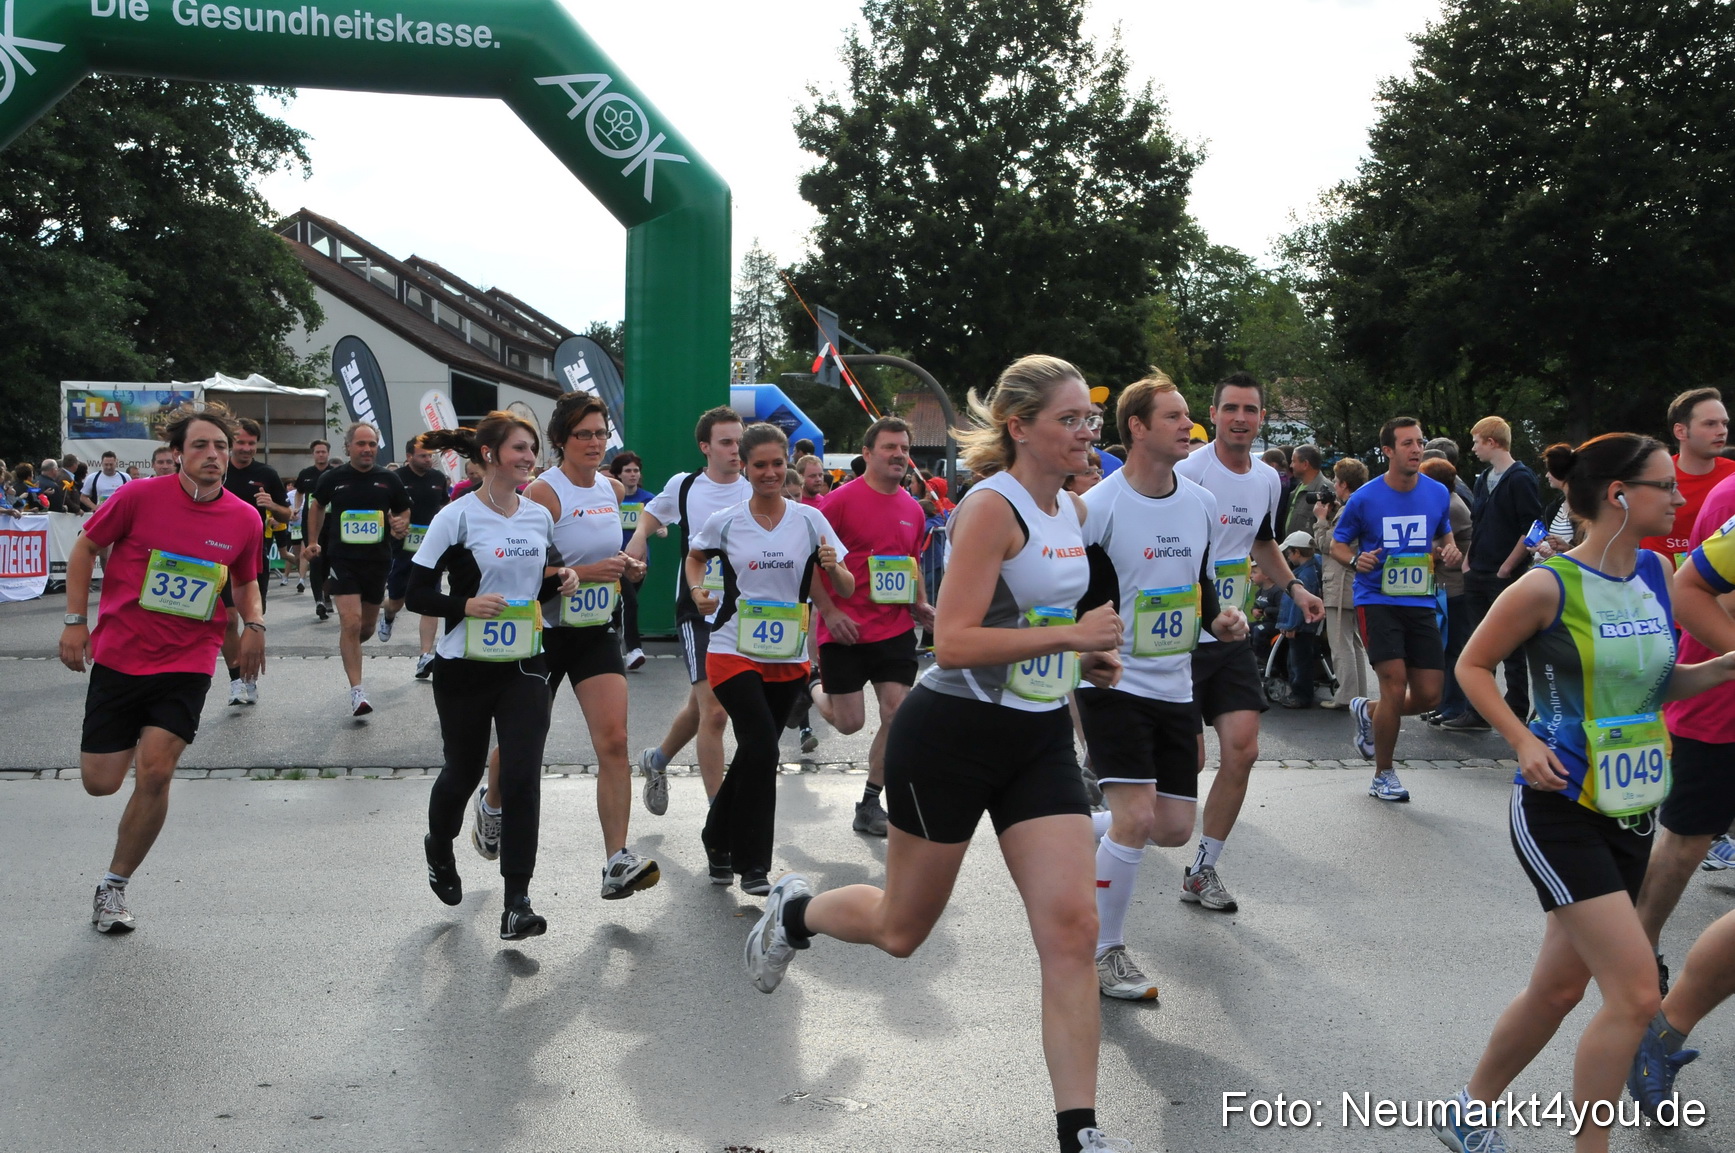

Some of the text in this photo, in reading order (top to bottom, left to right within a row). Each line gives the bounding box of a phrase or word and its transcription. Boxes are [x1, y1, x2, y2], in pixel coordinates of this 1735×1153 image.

[533, 73, 691, 203] AOK
[72, 401, 120, 418] TLA
[1232, 505, 1248, 513] Team
[343, 522, 378, 535] 1348
[1228, 515, 1253, 526] UniCredit
[506, 537, 528, 545] Team
[1156, 535, 1180, 543] Team
[505, 548, 539, 557] UniCredit
[1055, 546, 1087, 558] KLEBL
[1154, 547, 1191, 558] UniCredit
[759, 560, 794, 570] UniCredit
[875, 572, 905, 591] 360
[1387, 567, 1423, 585] 910
[151, 572, 208, 603] 337
[569, 586, 609, 613] 500
[752, 620, 784, 644] 49
[1151, 610, 1183, 639] 48
[1600, 617, 1662, 638] BOCK
[482, 621, 517, 646] 50
[1599, 748, 1663, 790] 1049
